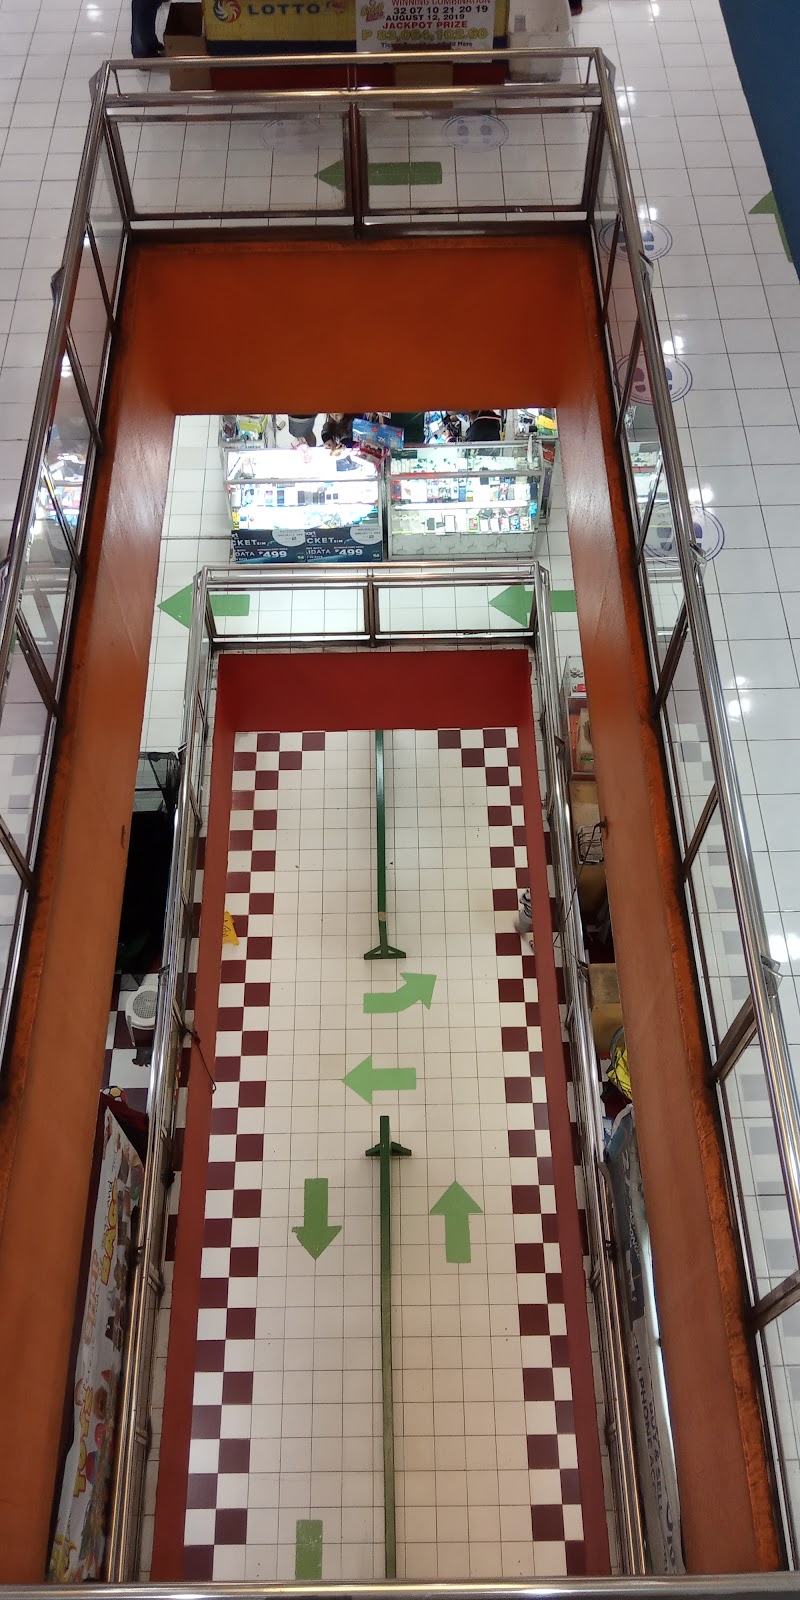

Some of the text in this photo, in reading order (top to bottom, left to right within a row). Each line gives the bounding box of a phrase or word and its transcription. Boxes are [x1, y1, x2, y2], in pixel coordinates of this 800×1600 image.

[248, 4, 320, 15] LOTTO
[393, 7, 407, 15] 32
[443, 6, 455, 14] 21
[476, 5, 489, 13] 19
[383, 20, 468, 29] JACKPOT PRIZE
[101, 1175, 119, 1287] BAGS
[73, 1386, 94, 1498] TOYS
